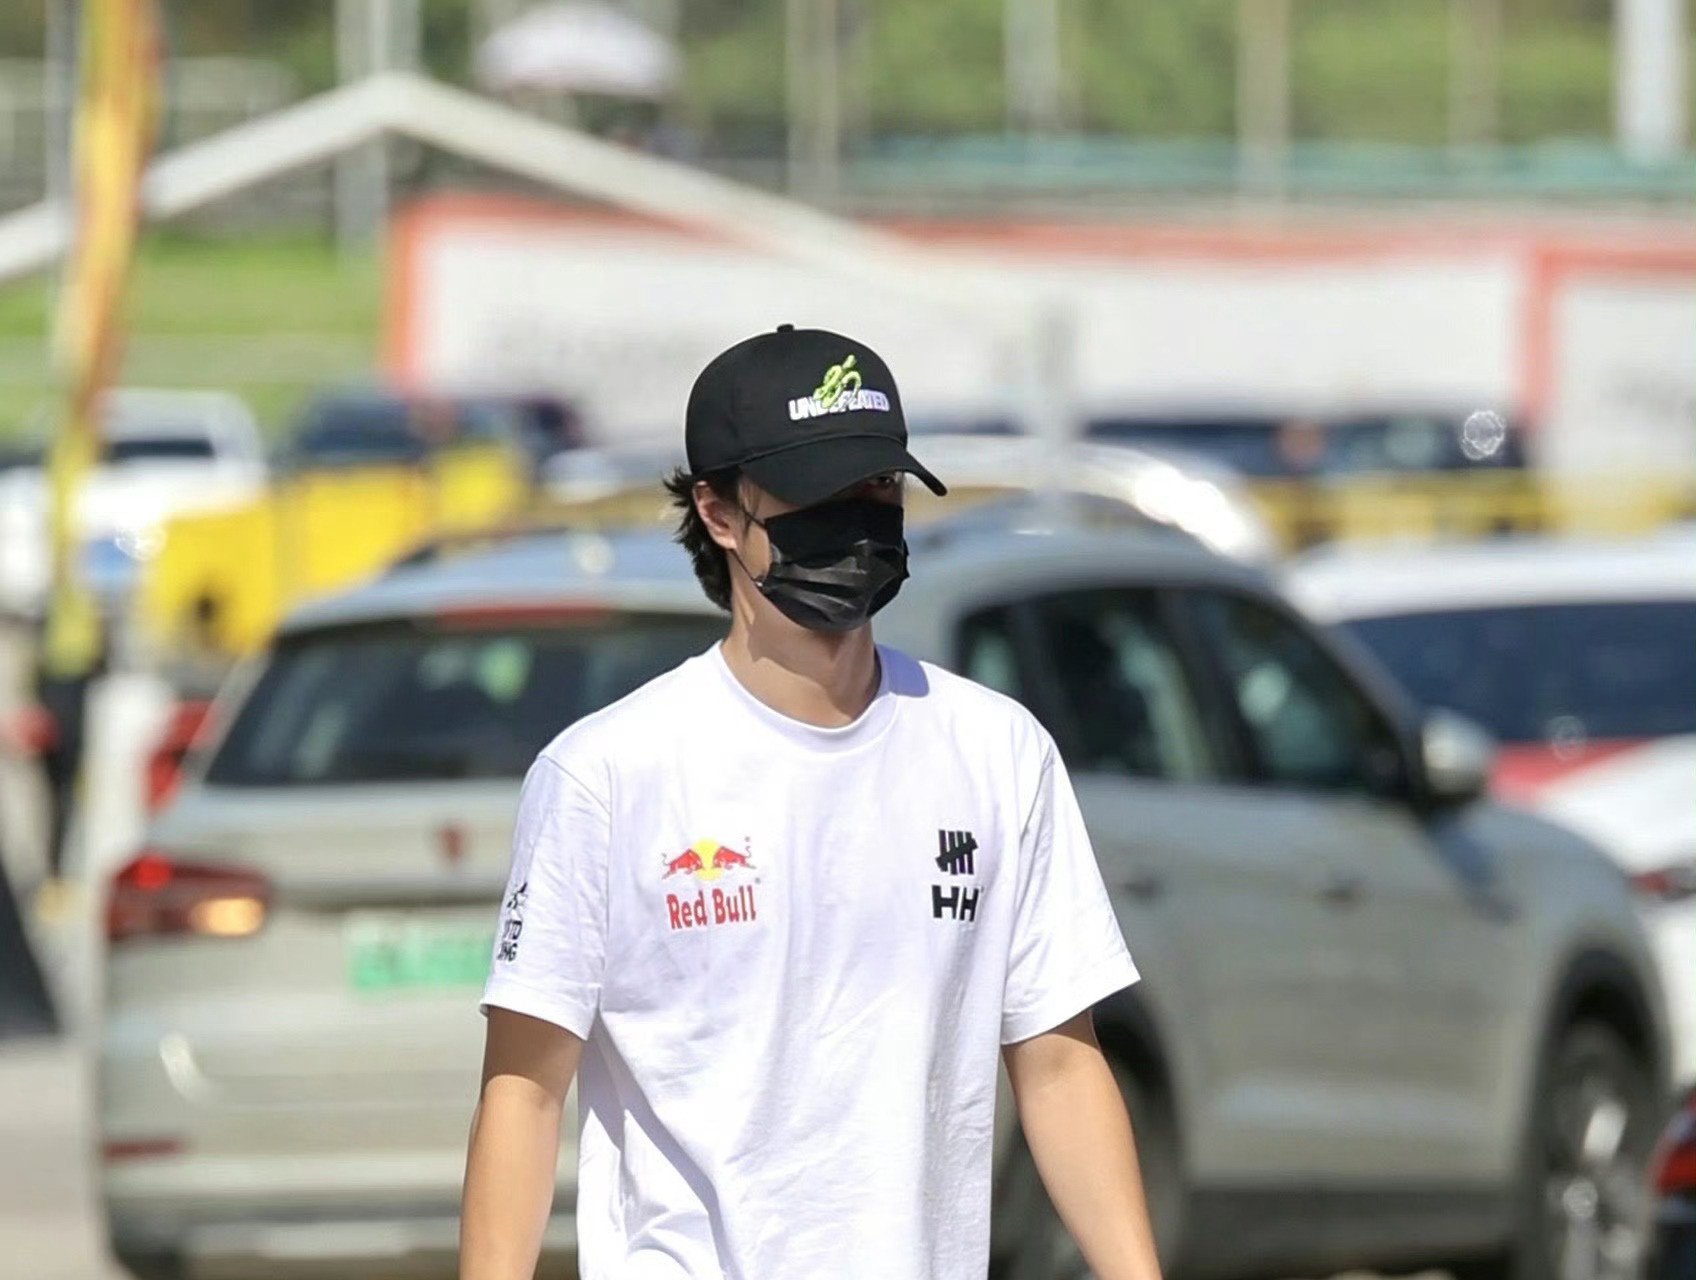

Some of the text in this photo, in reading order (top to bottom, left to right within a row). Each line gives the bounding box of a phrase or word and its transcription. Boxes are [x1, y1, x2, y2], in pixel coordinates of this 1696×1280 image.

[667, 885, 756, 930] Red Bull
[931, 884, 980, 923] HH
